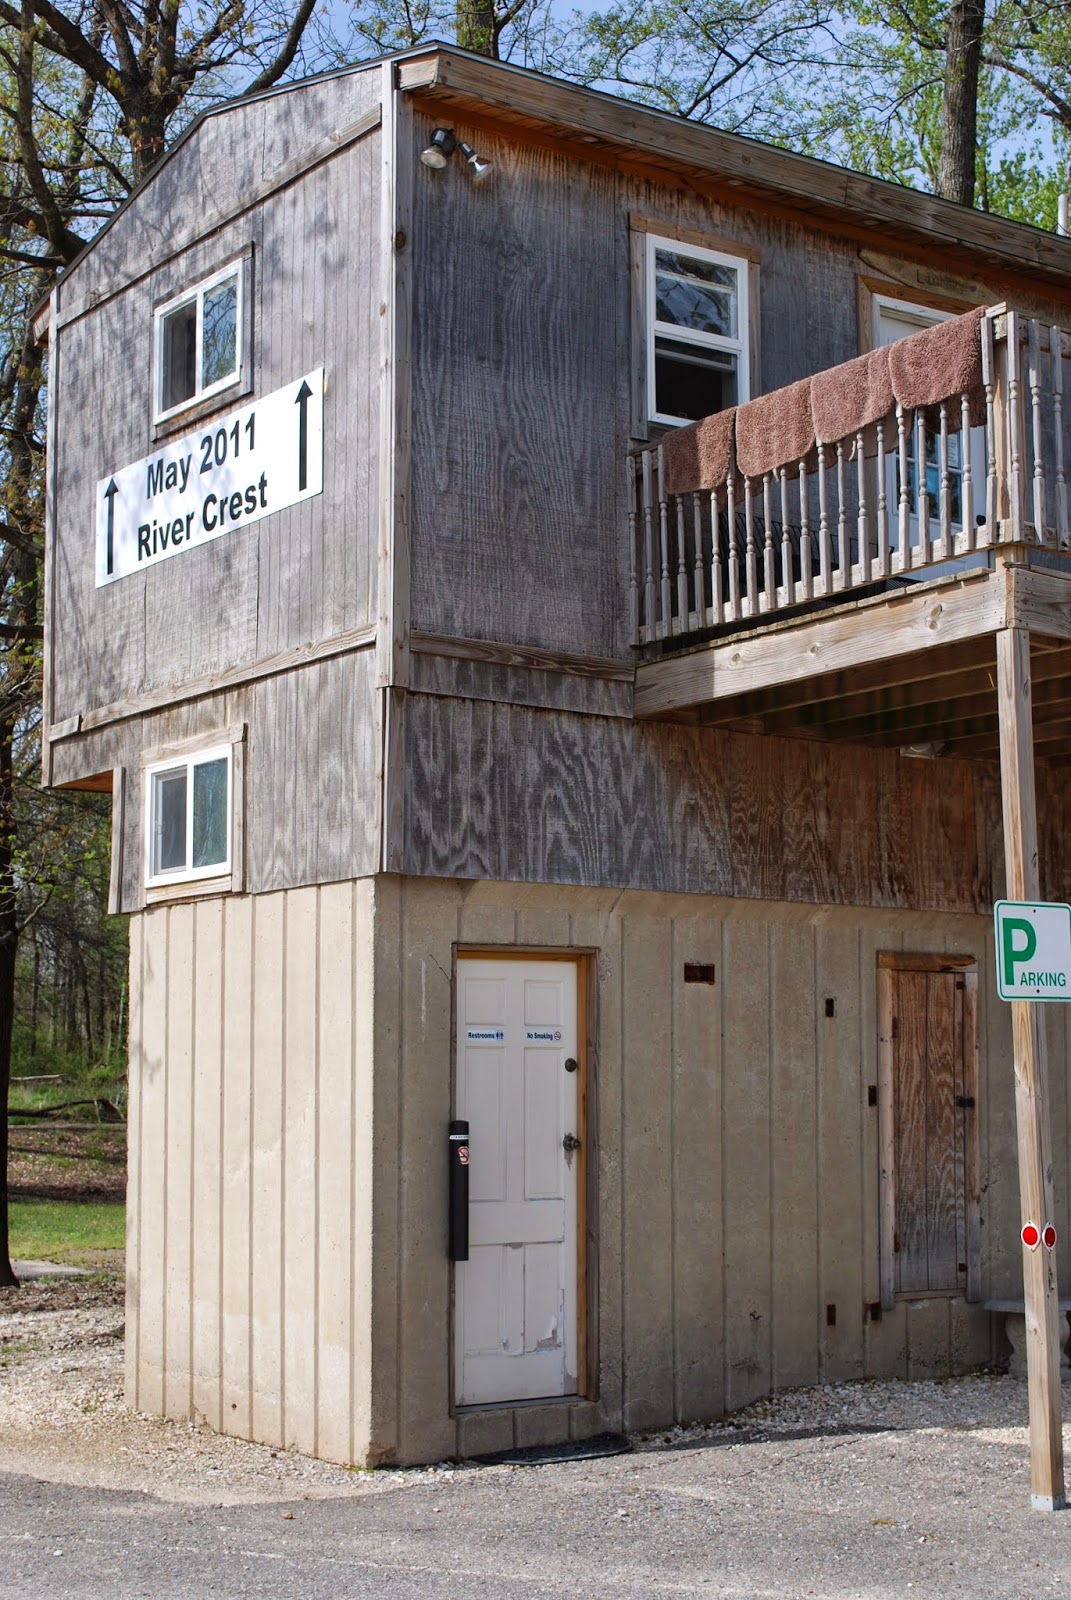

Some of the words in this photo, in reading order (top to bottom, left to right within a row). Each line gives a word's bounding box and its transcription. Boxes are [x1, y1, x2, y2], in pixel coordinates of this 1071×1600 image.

[147, 454, 192, 500] May
[199, 412, 256, 475] 2011
[137, 512, 195, 562] River
[202, 471, 268, 532] Crest
[468, 1031, 495, 1039] Restrooms
[534, 1032, 554, 1041] Smoking
